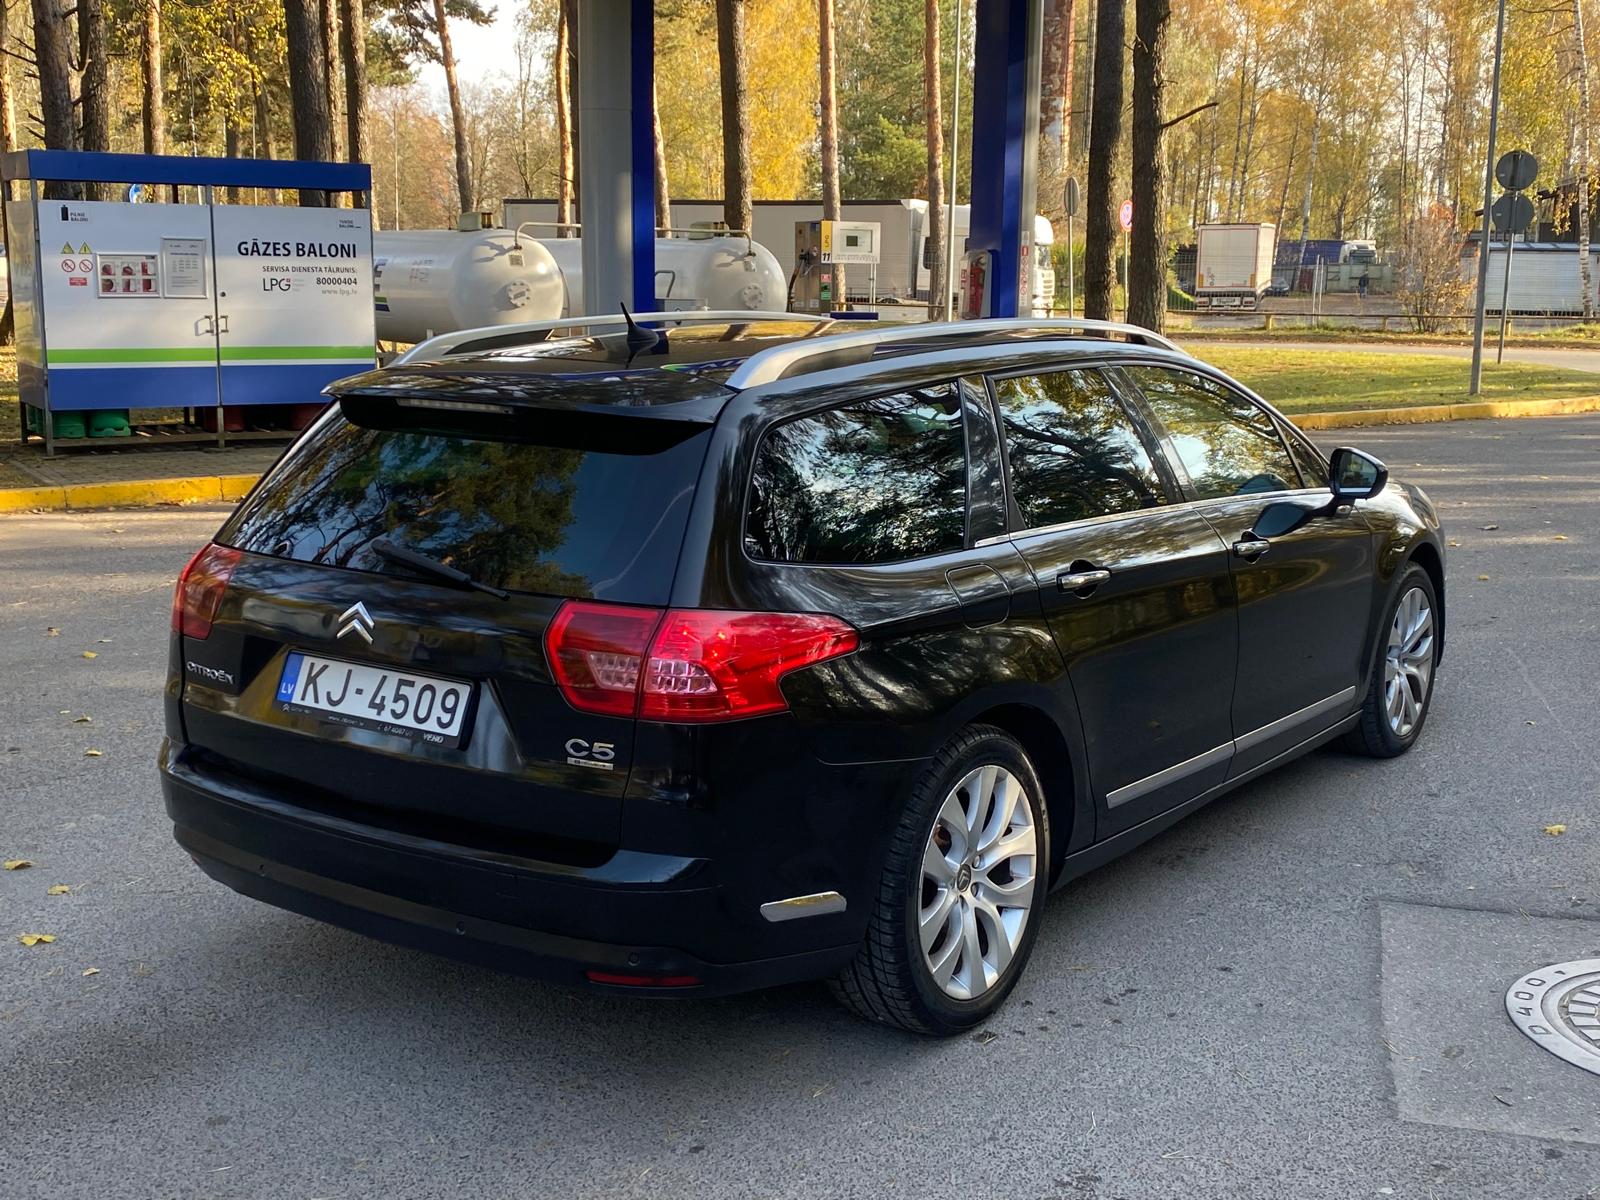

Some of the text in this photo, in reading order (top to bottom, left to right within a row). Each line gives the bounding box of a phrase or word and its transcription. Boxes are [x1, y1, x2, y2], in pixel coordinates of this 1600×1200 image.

[237, 238, 357, 258] GĀZES BALONI
[822, 253, 832, 262] 11
[324, 266, 358, 274] TĀLRUNIS:
[262, 278, 292, 292] LPG
[316, 277, 358, 286] 80000404
[186, 661, 234, 685] CITROËN
[281, 682, 294, 695] LV
[301, 662, 461, 729] KJ-4509
[564, 738, 616, 761] C5
